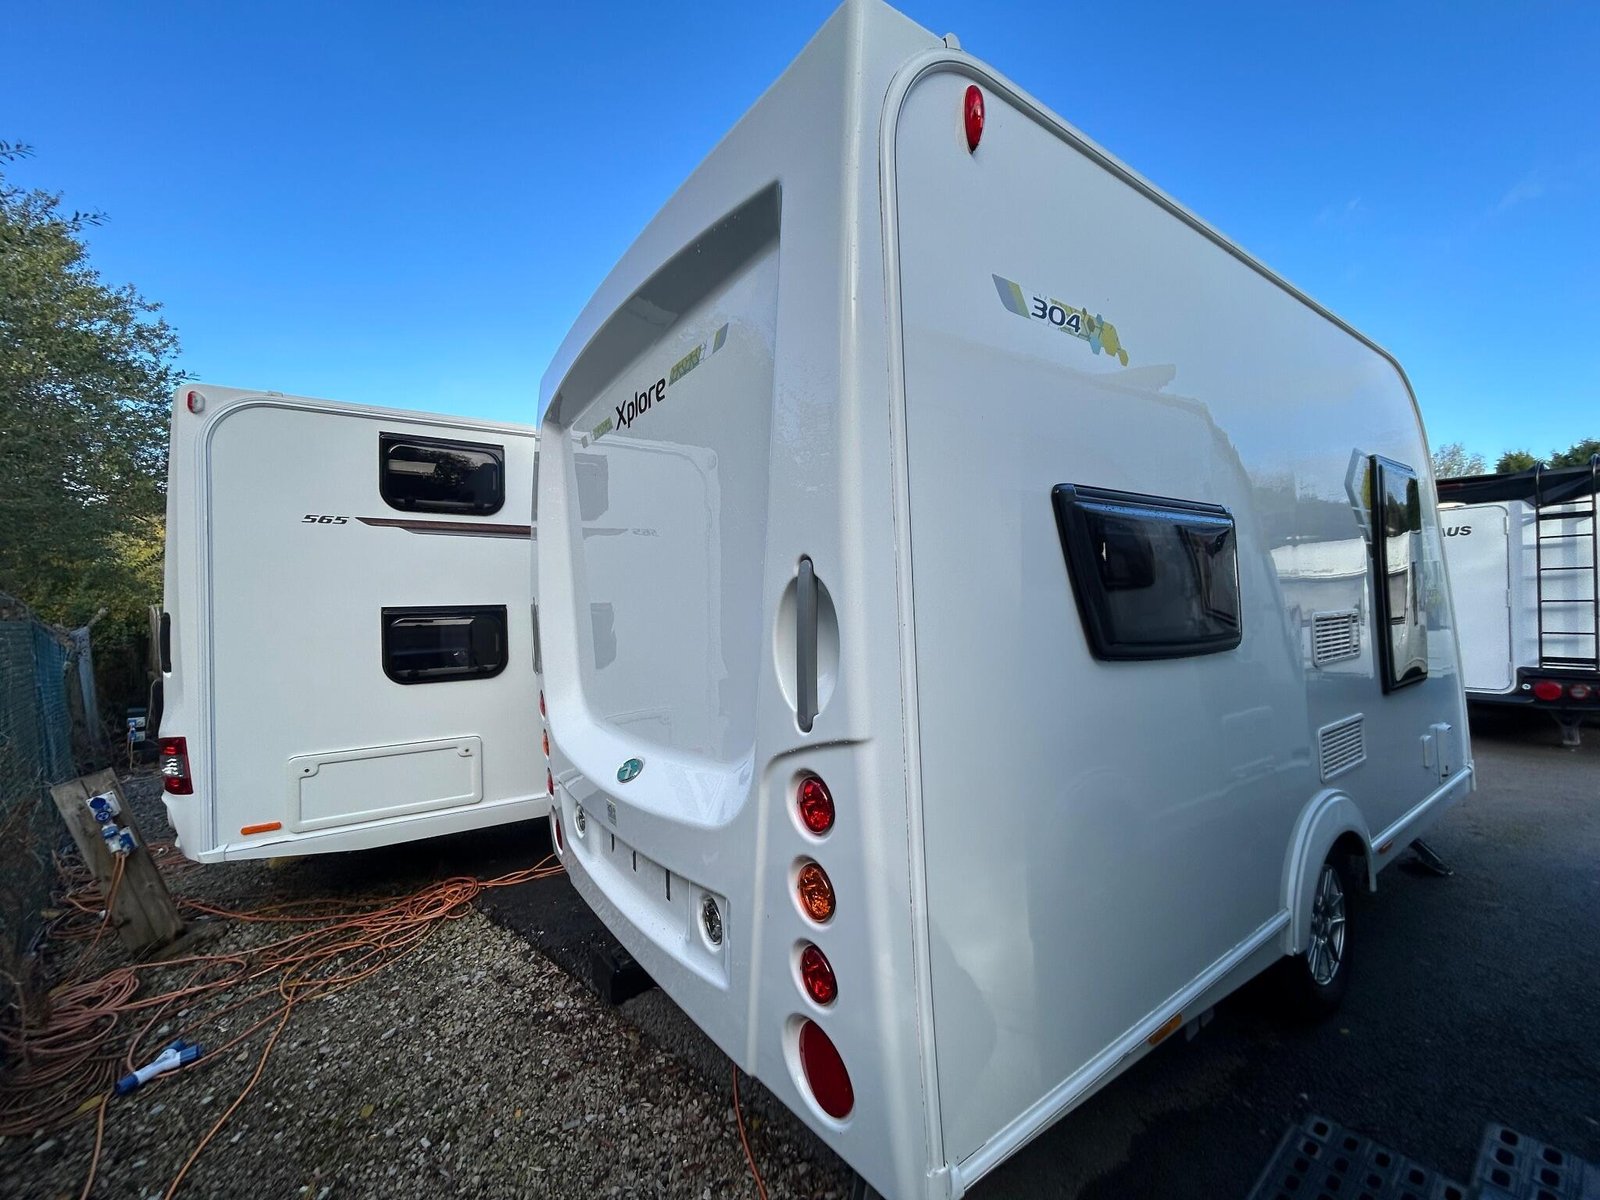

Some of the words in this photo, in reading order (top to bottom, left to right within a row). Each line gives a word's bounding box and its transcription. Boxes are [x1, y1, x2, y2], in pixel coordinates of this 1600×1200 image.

[1031, 296, 1081, 333] 304
[615, 378, 666, 431] Xplore
[301, 514, 350, 525] 565
